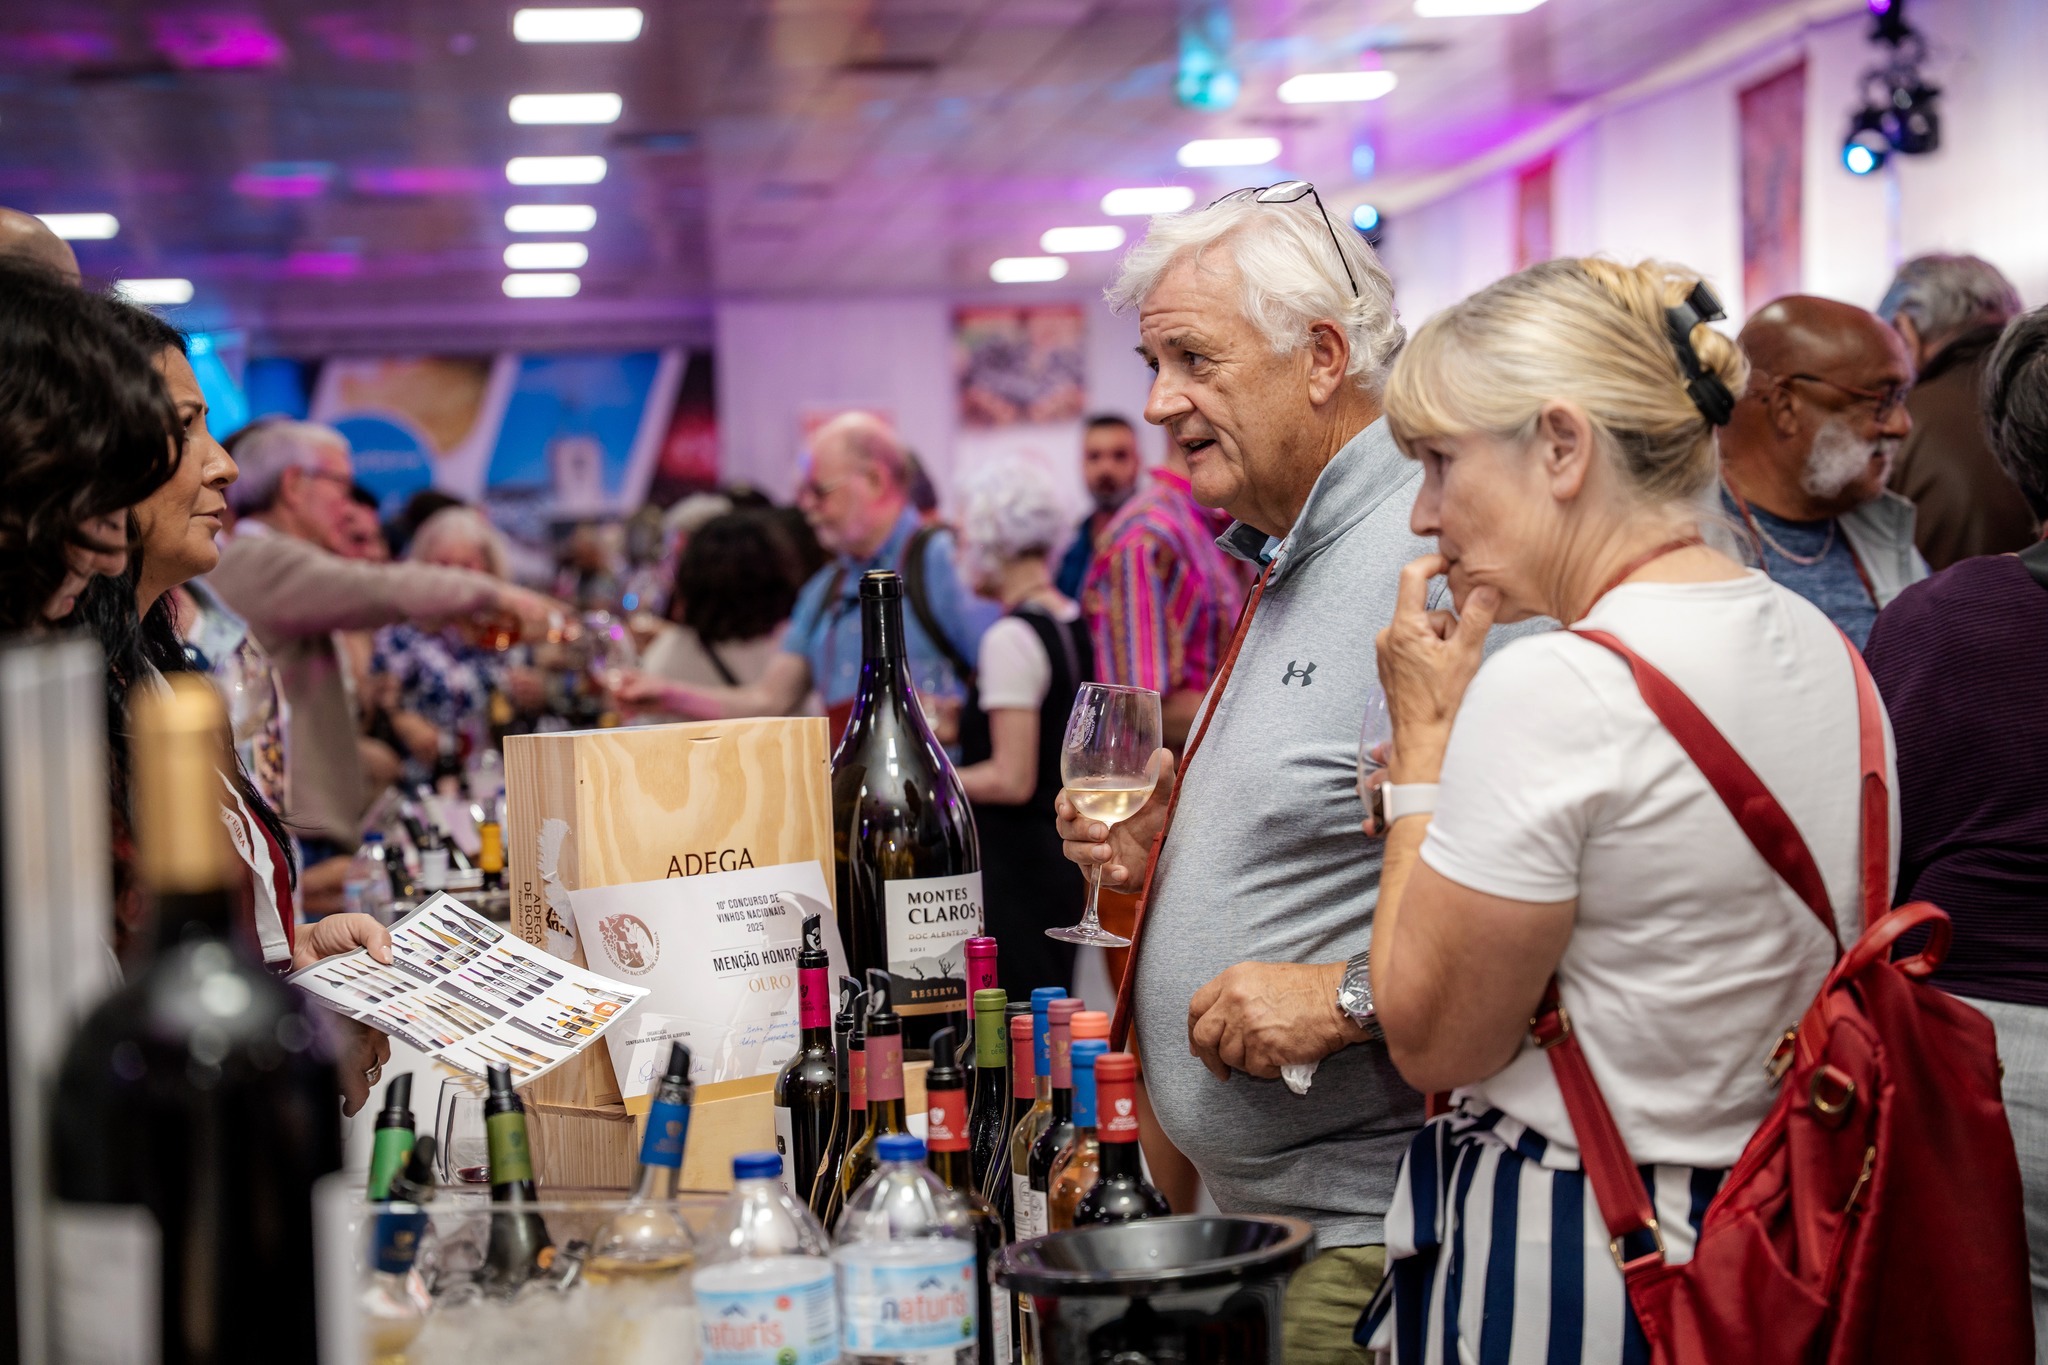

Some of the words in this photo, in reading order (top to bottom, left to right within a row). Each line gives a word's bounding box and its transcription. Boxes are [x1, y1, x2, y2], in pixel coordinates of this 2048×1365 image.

[666, 848, 754, 879] ADEGA
[524, 881, 532, 900] DE
[908, 887, 968, 905] MONTES
[728, 895, 769, 909] CONCURSO
[769, 893, 780, 903] DE
[533, 894, 542, 944] ADEGA
[716, 911, 745, 923] VINHOS
[746, 906, 786, 920] NACIONAIS
[908, 902, 976, 925] CLAROS
[524, 905, 533, 944] BORB
[746, 922, 765, 933] 2025
[908, 932, 928, 941] DOC
[930, 929, 969, 939] ALENTEJO
[713, 950, 760, 972] MENÇÃO
[761, 946, 803, 965] HONRO
[749, 975, 791, 993] OURO
[910, 986, 959, 999] RESERVA
